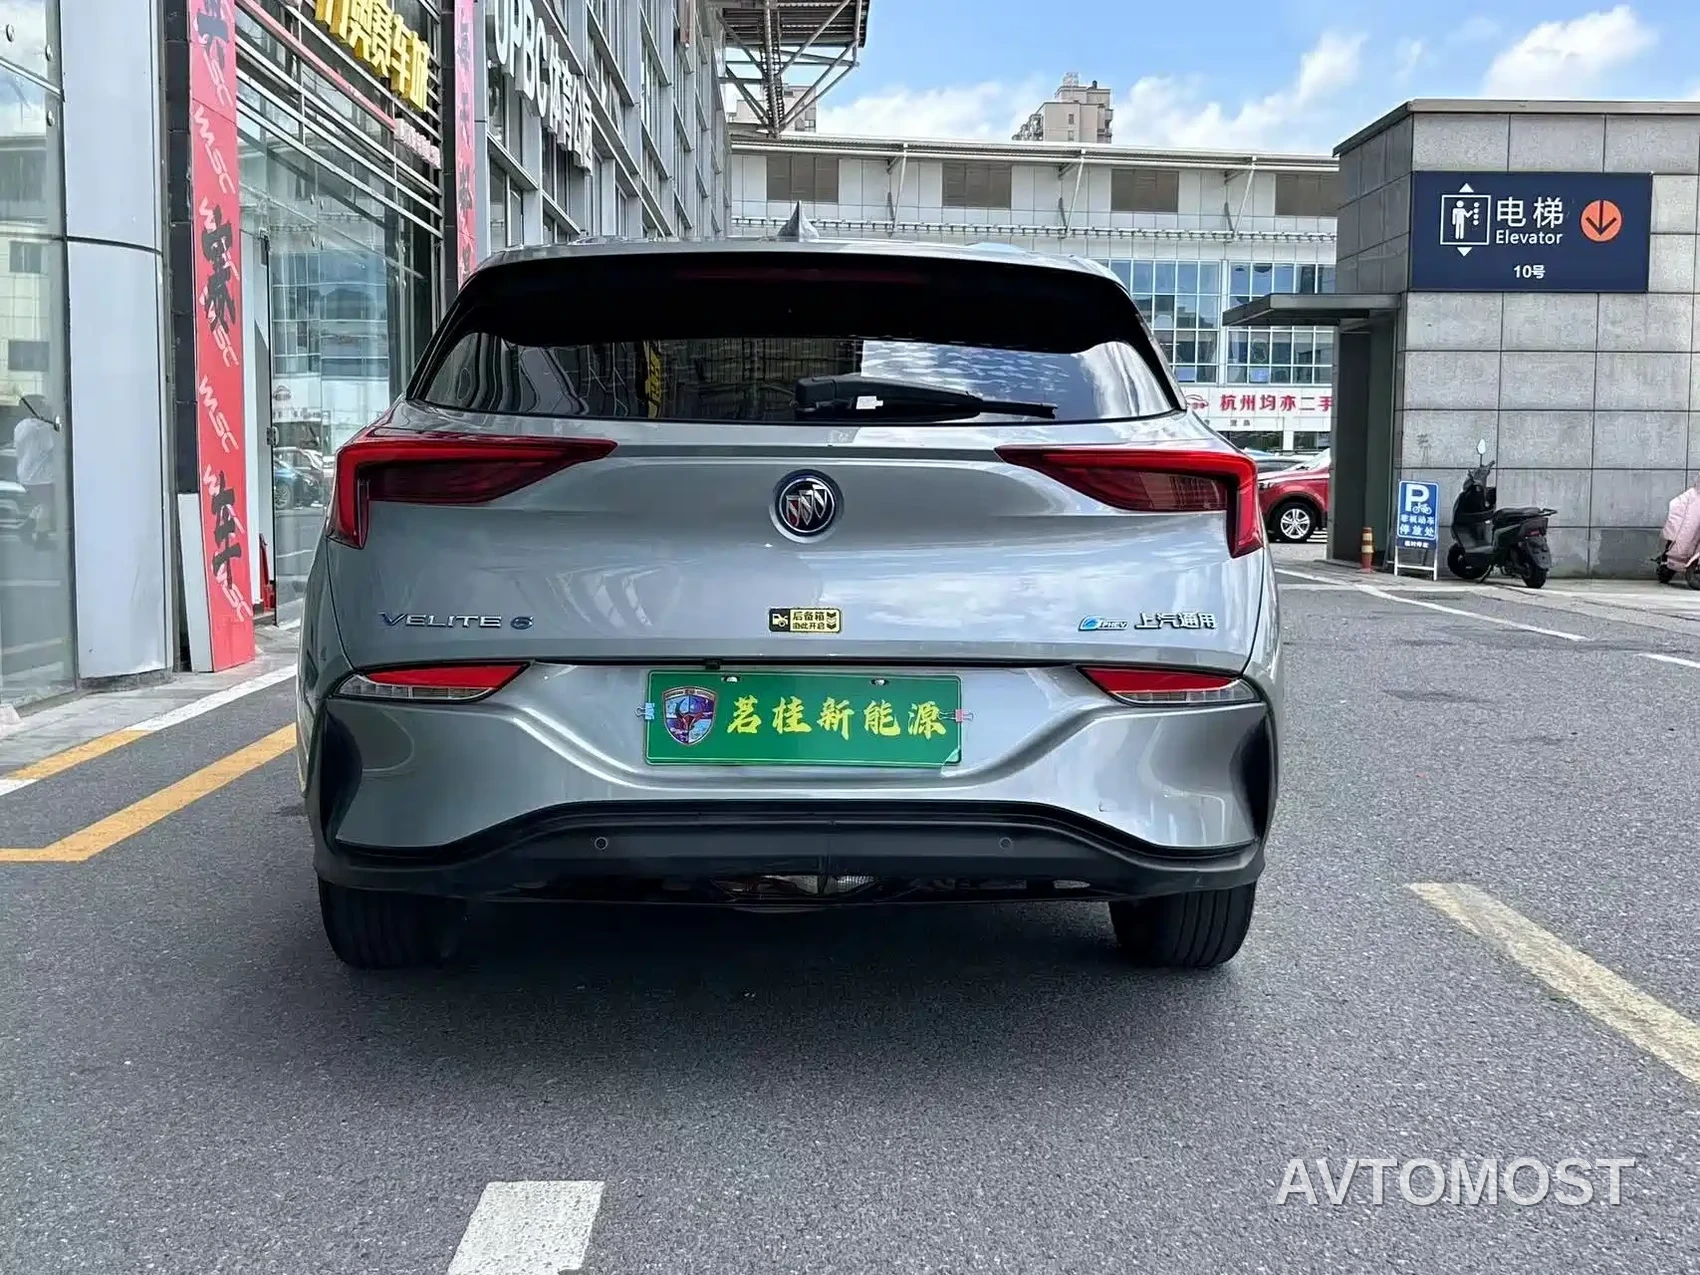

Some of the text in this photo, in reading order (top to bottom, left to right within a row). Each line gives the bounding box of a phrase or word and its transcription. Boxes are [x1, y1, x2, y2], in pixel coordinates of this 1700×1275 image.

[1497, 196, 1564, 228] 电梯
[1496, 230, 1563, 244] Elevator
[1514, 264, 1546, 279] 10号
[1405, 483, 1430, 512] P
[378, 611, 534, 630] VELITE 6
[793, 611, 825, 621] 后备箱
[1134, 612, 1217, 630] 上汽通用
